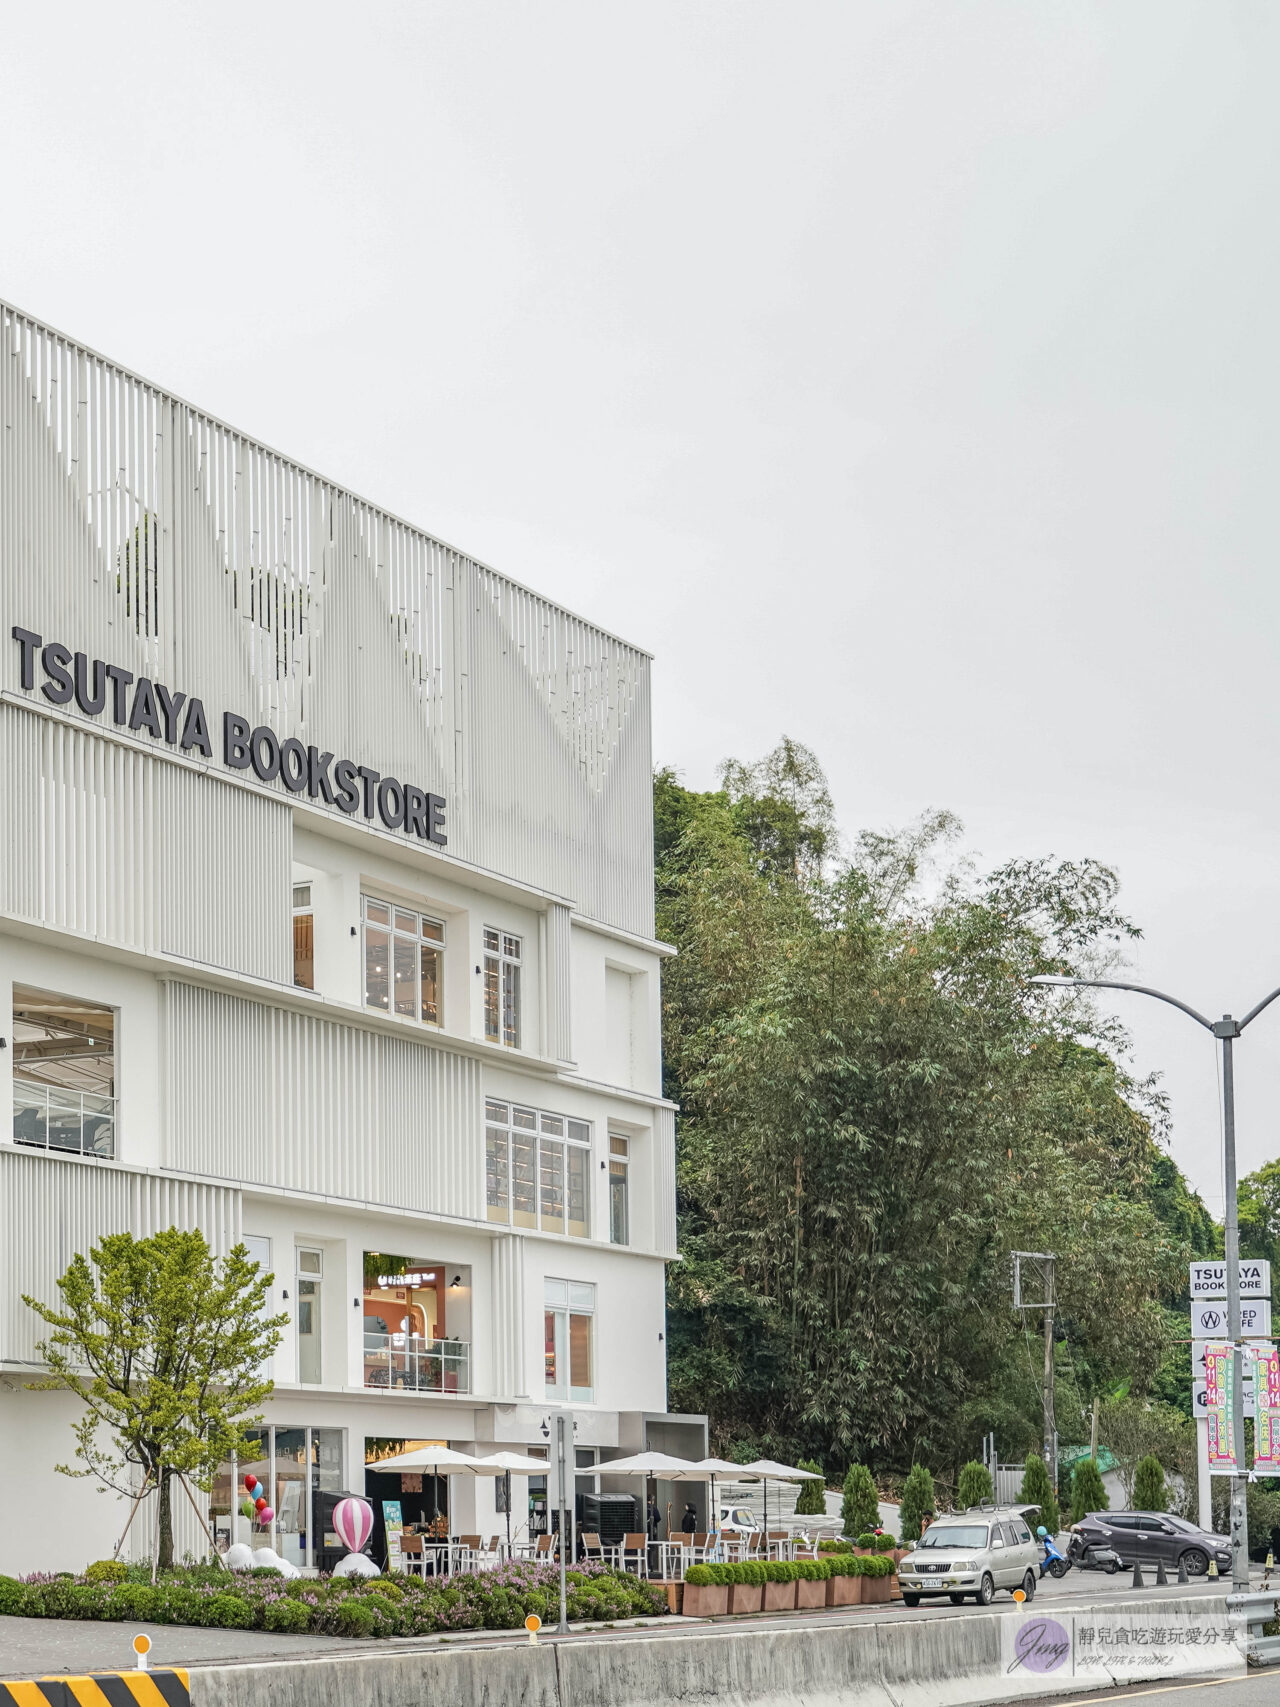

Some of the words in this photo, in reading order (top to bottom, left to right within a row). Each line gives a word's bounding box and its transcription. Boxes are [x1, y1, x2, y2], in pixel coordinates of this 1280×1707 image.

[12, 626, 212, 757] TSUTAYA
[224, 712, 447, 846] BOOKSTORE
[1195, 1267, 1261, 1280] TSUYA
[1195, 1281, 1261, 1291] BOOKORE
